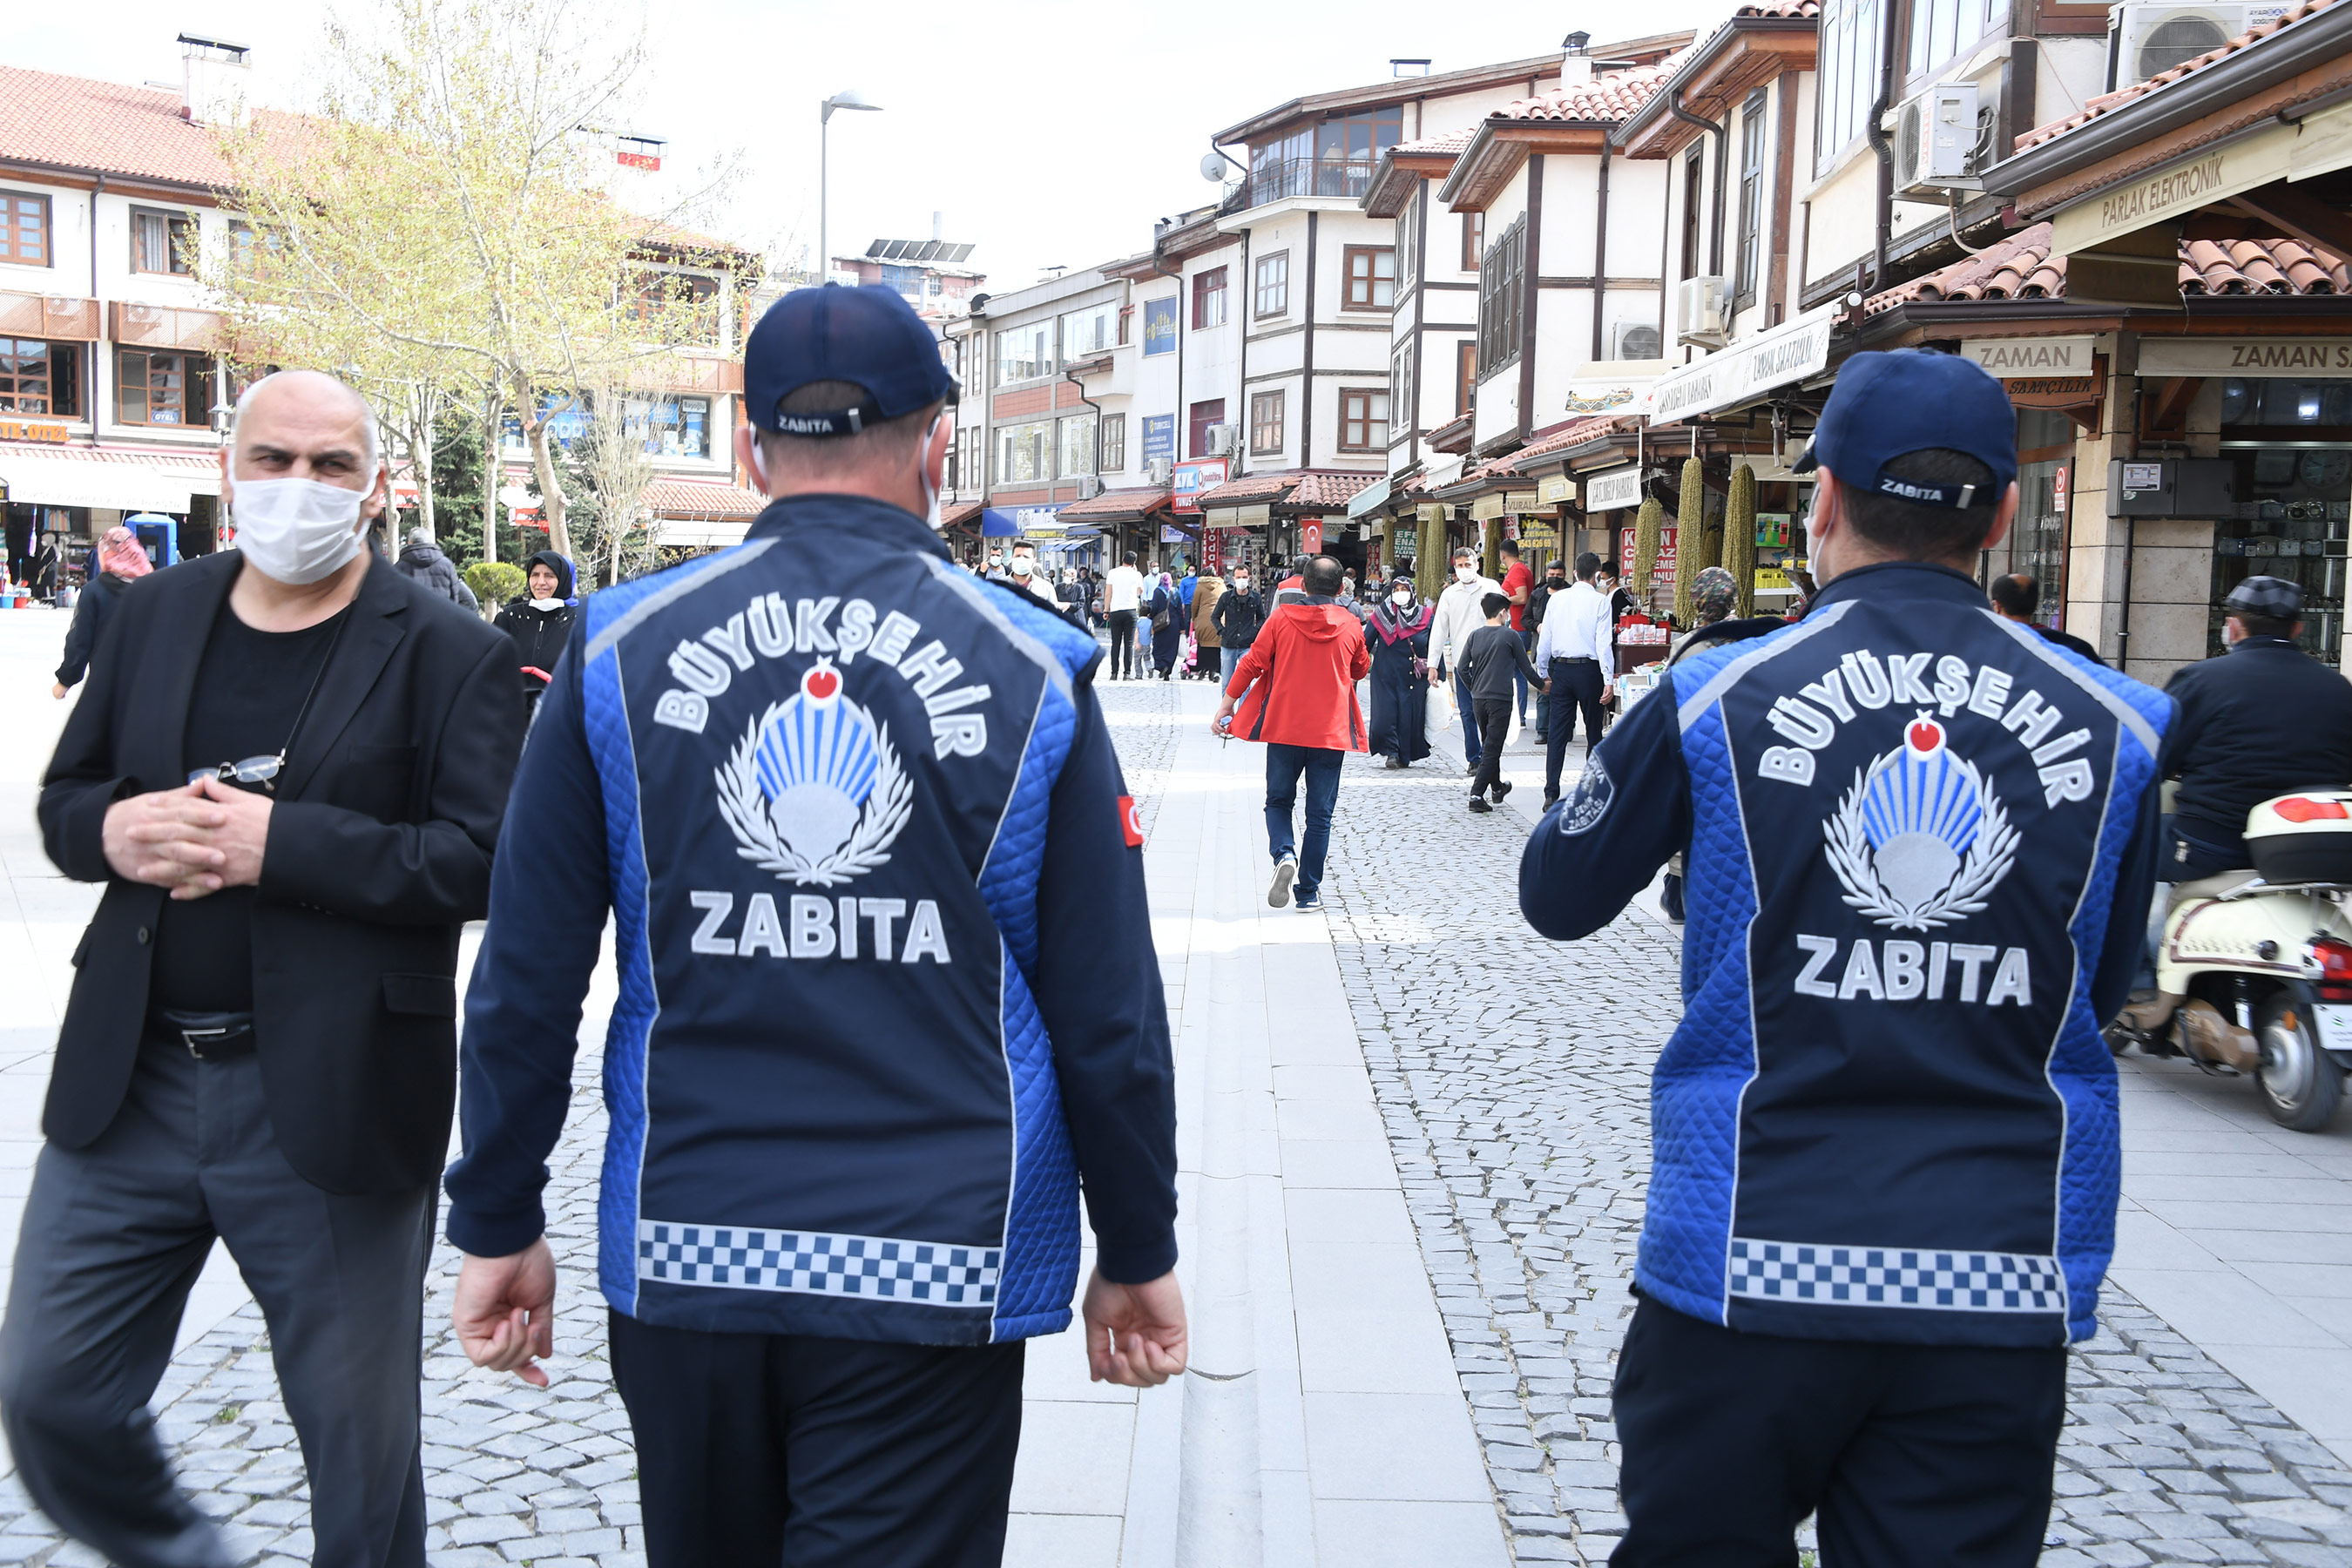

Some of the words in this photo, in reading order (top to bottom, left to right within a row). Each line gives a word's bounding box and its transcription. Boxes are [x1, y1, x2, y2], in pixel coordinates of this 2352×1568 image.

[2102, 186, 2147, 228] PARLAK
[2149, 152, 2224, 212] ELEKTRONİK
[1980, 346, 2072, 368] ZAMAN
[2230, 346, 2328, 368] ZAMAN
[2335, 346, 2352, 368] S
[2007, 378, 2095, 395] SAATÇİLİK
[27, 424, 71, 443] OTEL
[779, 415, 834, 433] ZABITA
[1881, 478, 1943, 501] ZABITA
[1508, 501, 1533, 510] VURAL
[654, 591, 992, 760] BÜYÜKŞEHİR
[1758, 649, 2094, 809] BÜYÜKŞEHİR
[1568, 798, 1605, 830] ZABITASI
[689, 890, 952, 963] ZABITA
[1794, 933, 2033, 1006] ZABITA
